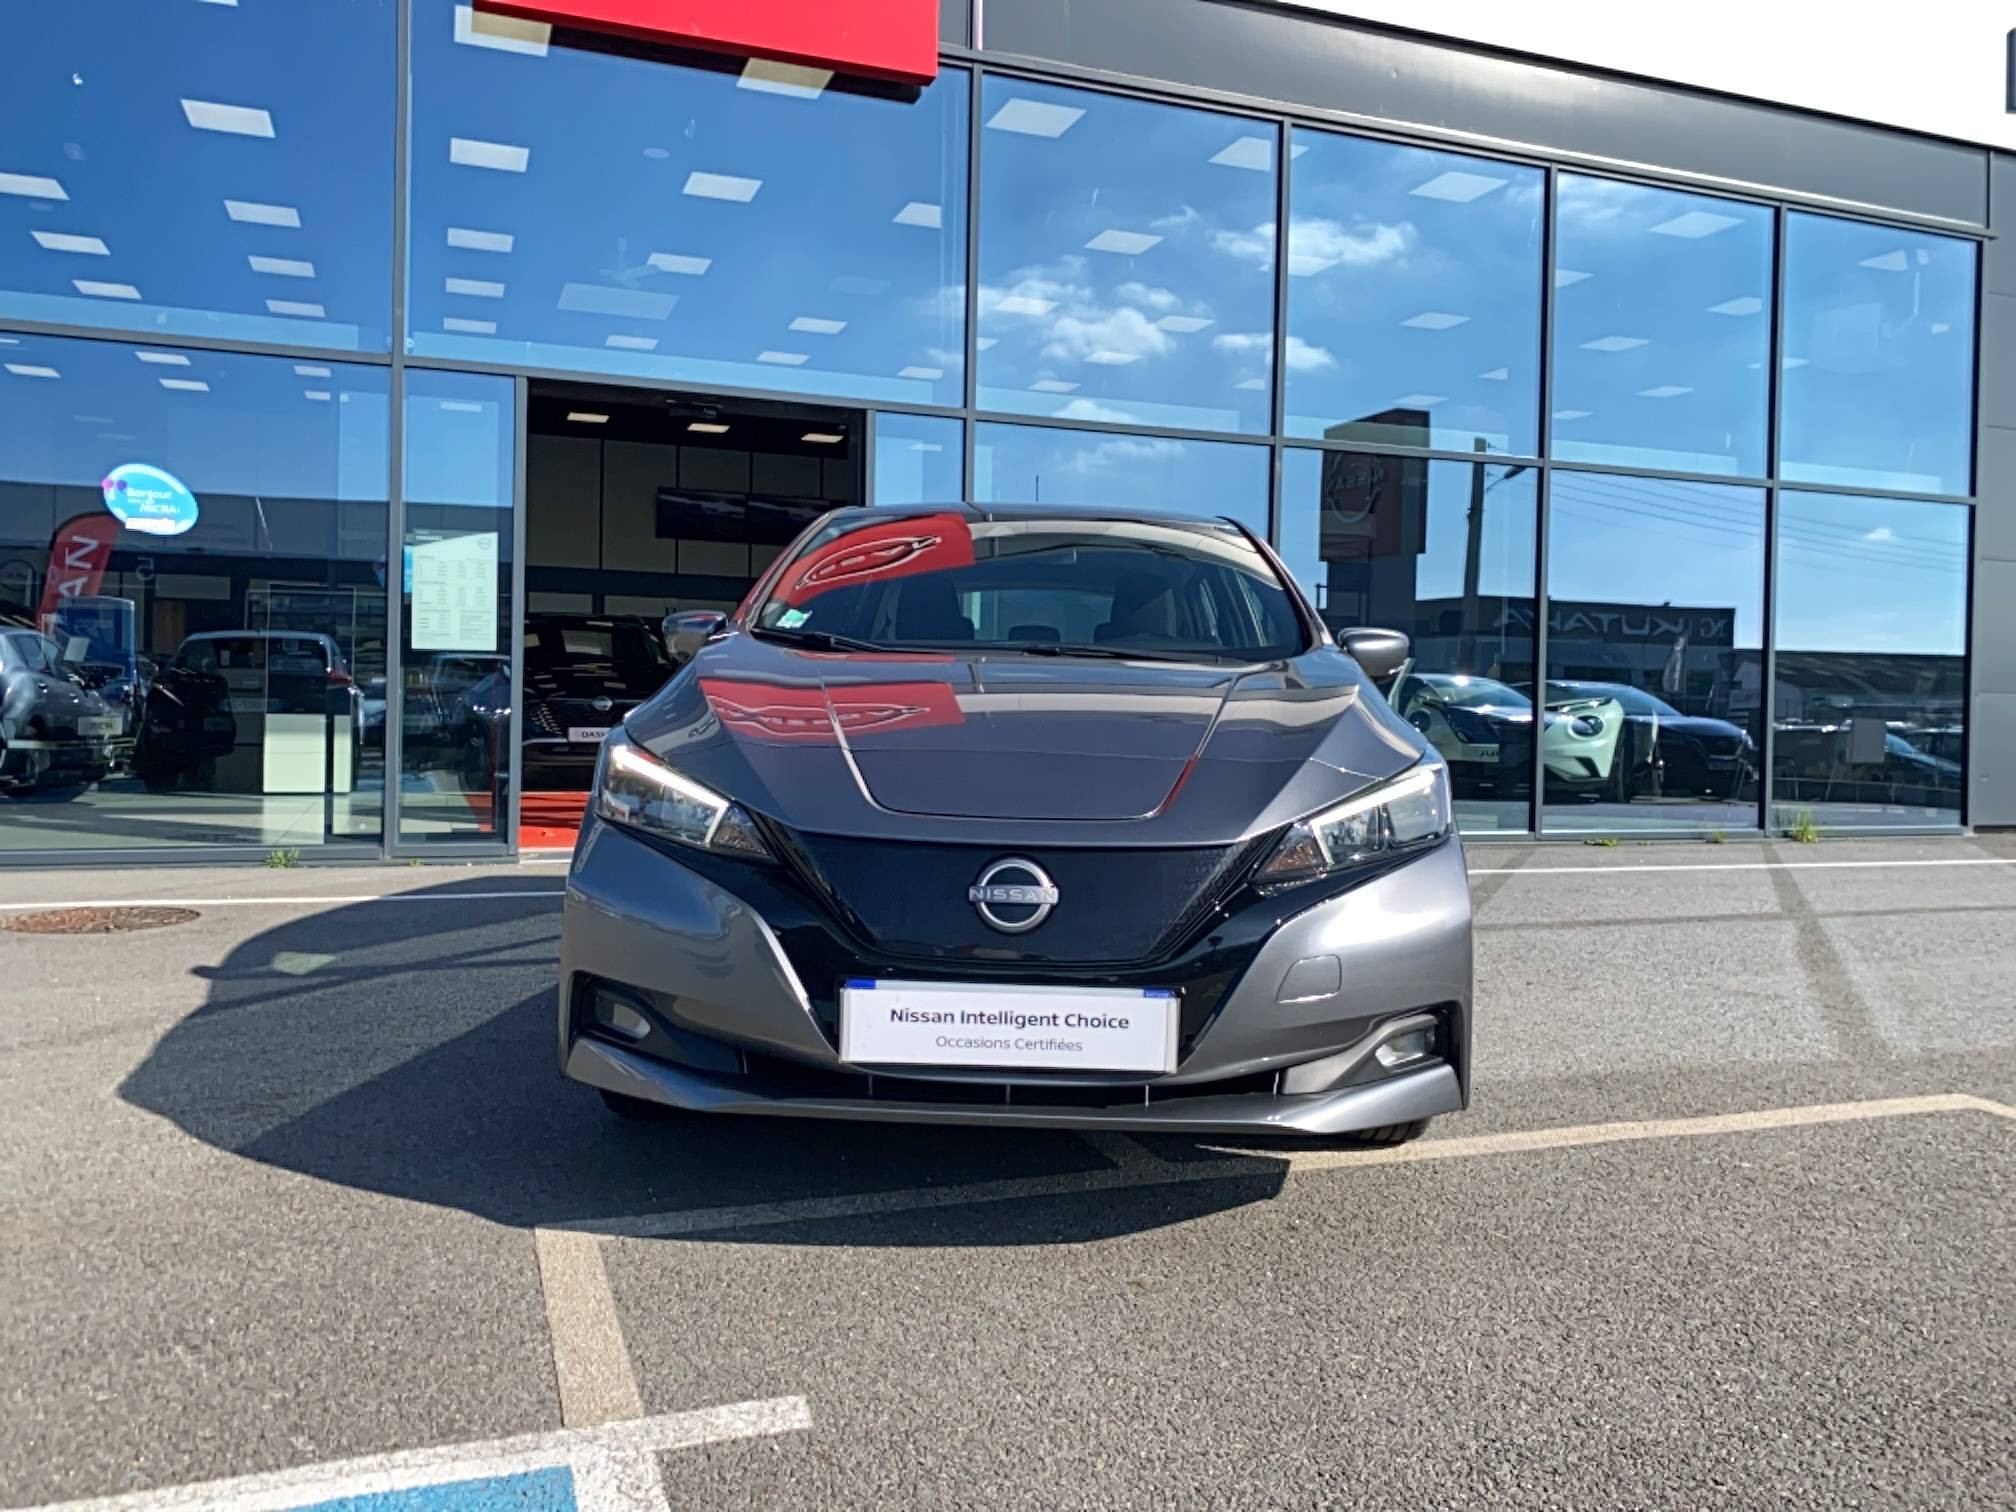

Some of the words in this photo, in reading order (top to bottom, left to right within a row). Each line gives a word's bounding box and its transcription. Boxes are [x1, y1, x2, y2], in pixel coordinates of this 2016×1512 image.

[970, 887, 1058, 901] NISSAN
[890, 1008, 955, 1024] Nissan
[960, 1010, 1058, 1030] Intelligent
[1064, 1013, 1129, 1029] Choice
[935, 1036, 1011, 1049] Occasions
[1014, 1037, 1083, 1051] Certifiées
